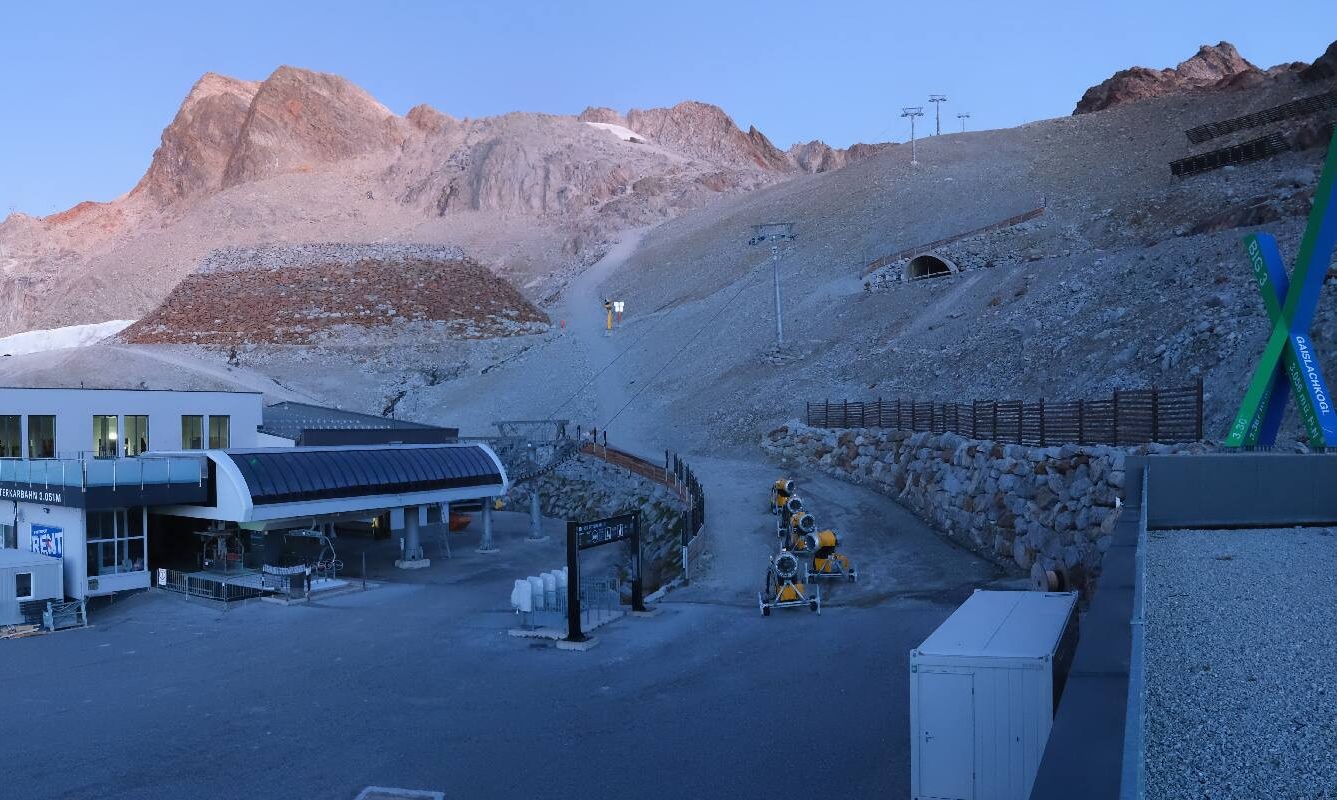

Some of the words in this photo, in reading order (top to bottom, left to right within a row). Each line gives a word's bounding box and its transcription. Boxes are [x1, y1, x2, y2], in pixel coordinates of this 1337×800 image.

[1248, 239, 1263, 273] BIG
[1259, 272, 1268, 287] 3
[1296, 335, 1330, 416] GAISLACHKOGL
[31, 533, 63, 558] RENT
